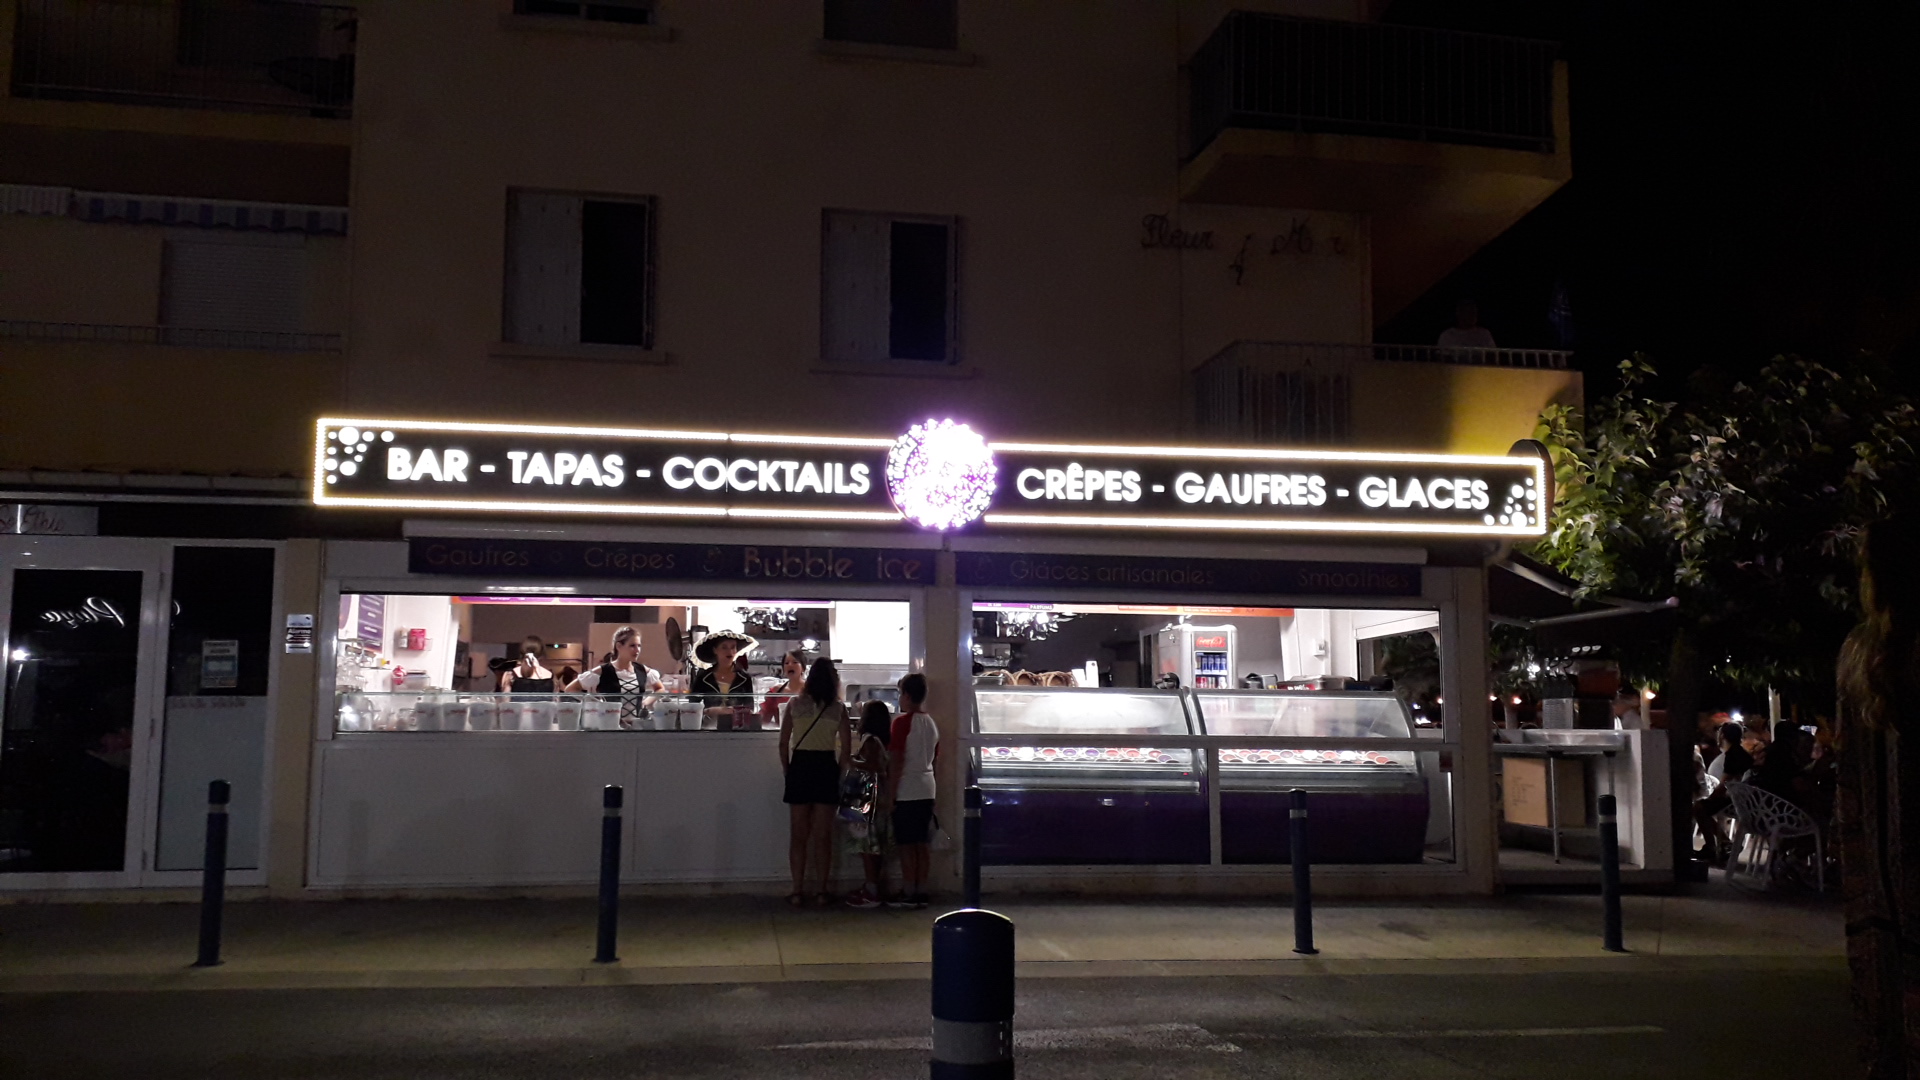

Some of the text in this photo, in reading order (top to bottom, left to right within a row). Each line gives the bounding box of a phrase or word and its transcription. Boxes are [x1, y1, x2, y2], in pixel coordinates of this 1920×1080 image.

[1141, 211, 1214, 249] Fleur
[387, 447, 468, 482] BAR
[507, 451, 625, 487] TAPAS
[662, 456, 870, 495] COCKTAILS
[1016, 462, 1142, 502] CRÊPES
[1175, 472, 1327, 505] GAUFRES
[1359, 476, 1490, 510] GLACES
[425, 544, 675, 572] Gaufres Crêpes
[744, 546, 853, 578] Bubble
[1096, 564, 1216, 585] artisanales
[1299, 568, 1409, 589] Smoothies
